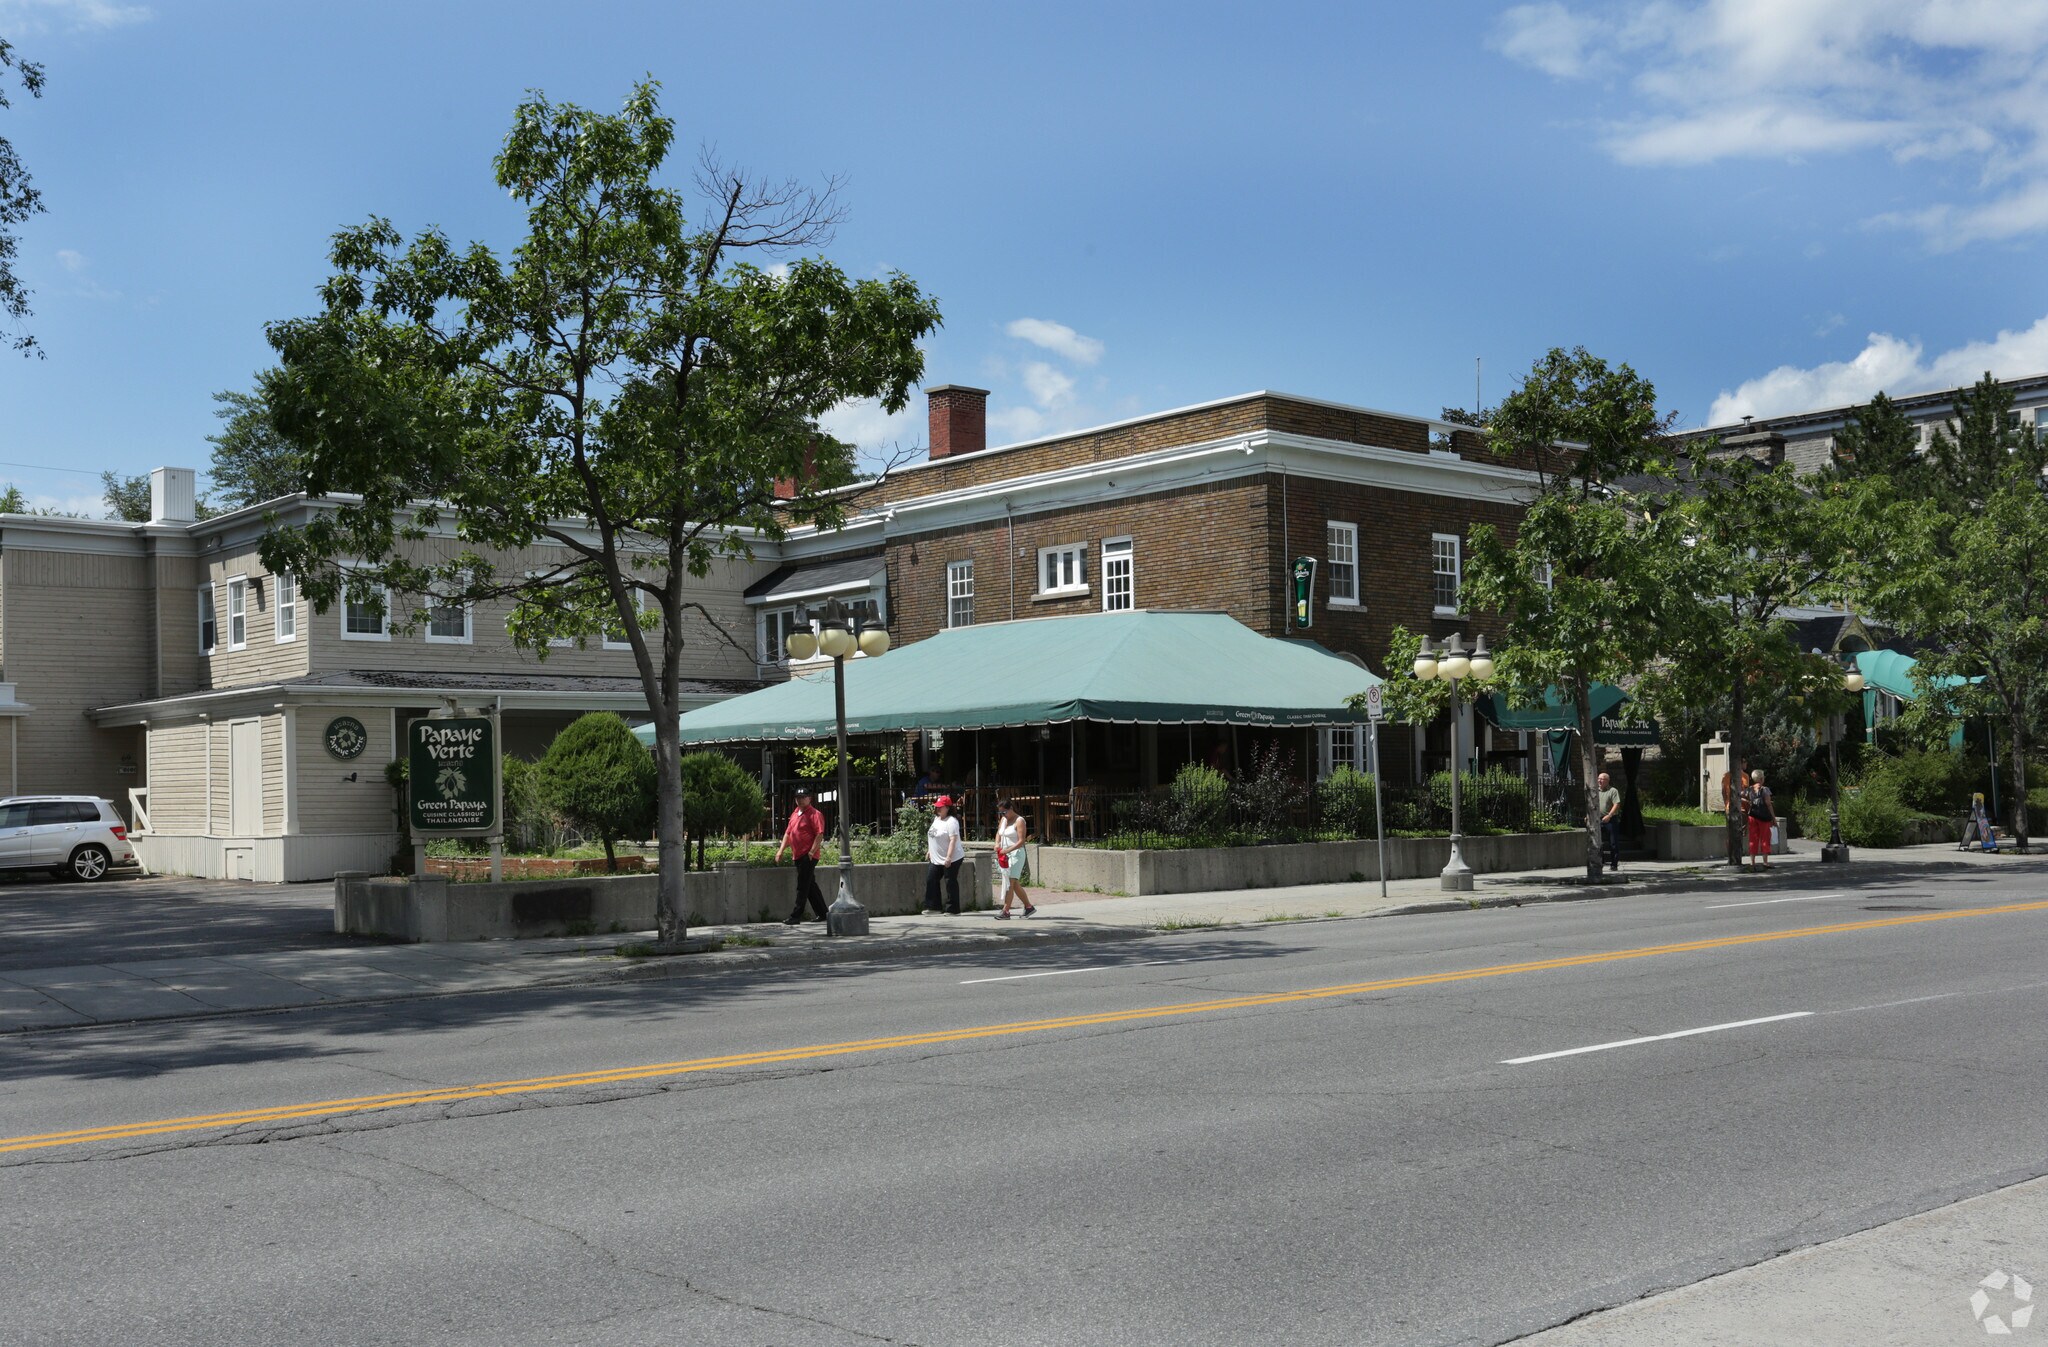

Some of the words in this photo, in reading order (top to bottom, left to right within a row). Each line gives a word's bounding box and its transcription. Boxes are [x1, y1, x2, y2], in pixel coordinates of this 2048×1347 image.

[419, 725, 482, 746] Papaye
[427, 744, 475, 759] Verte
[417, 799, 447, 810] Green
[449, 799, 487, 811] Papaya
